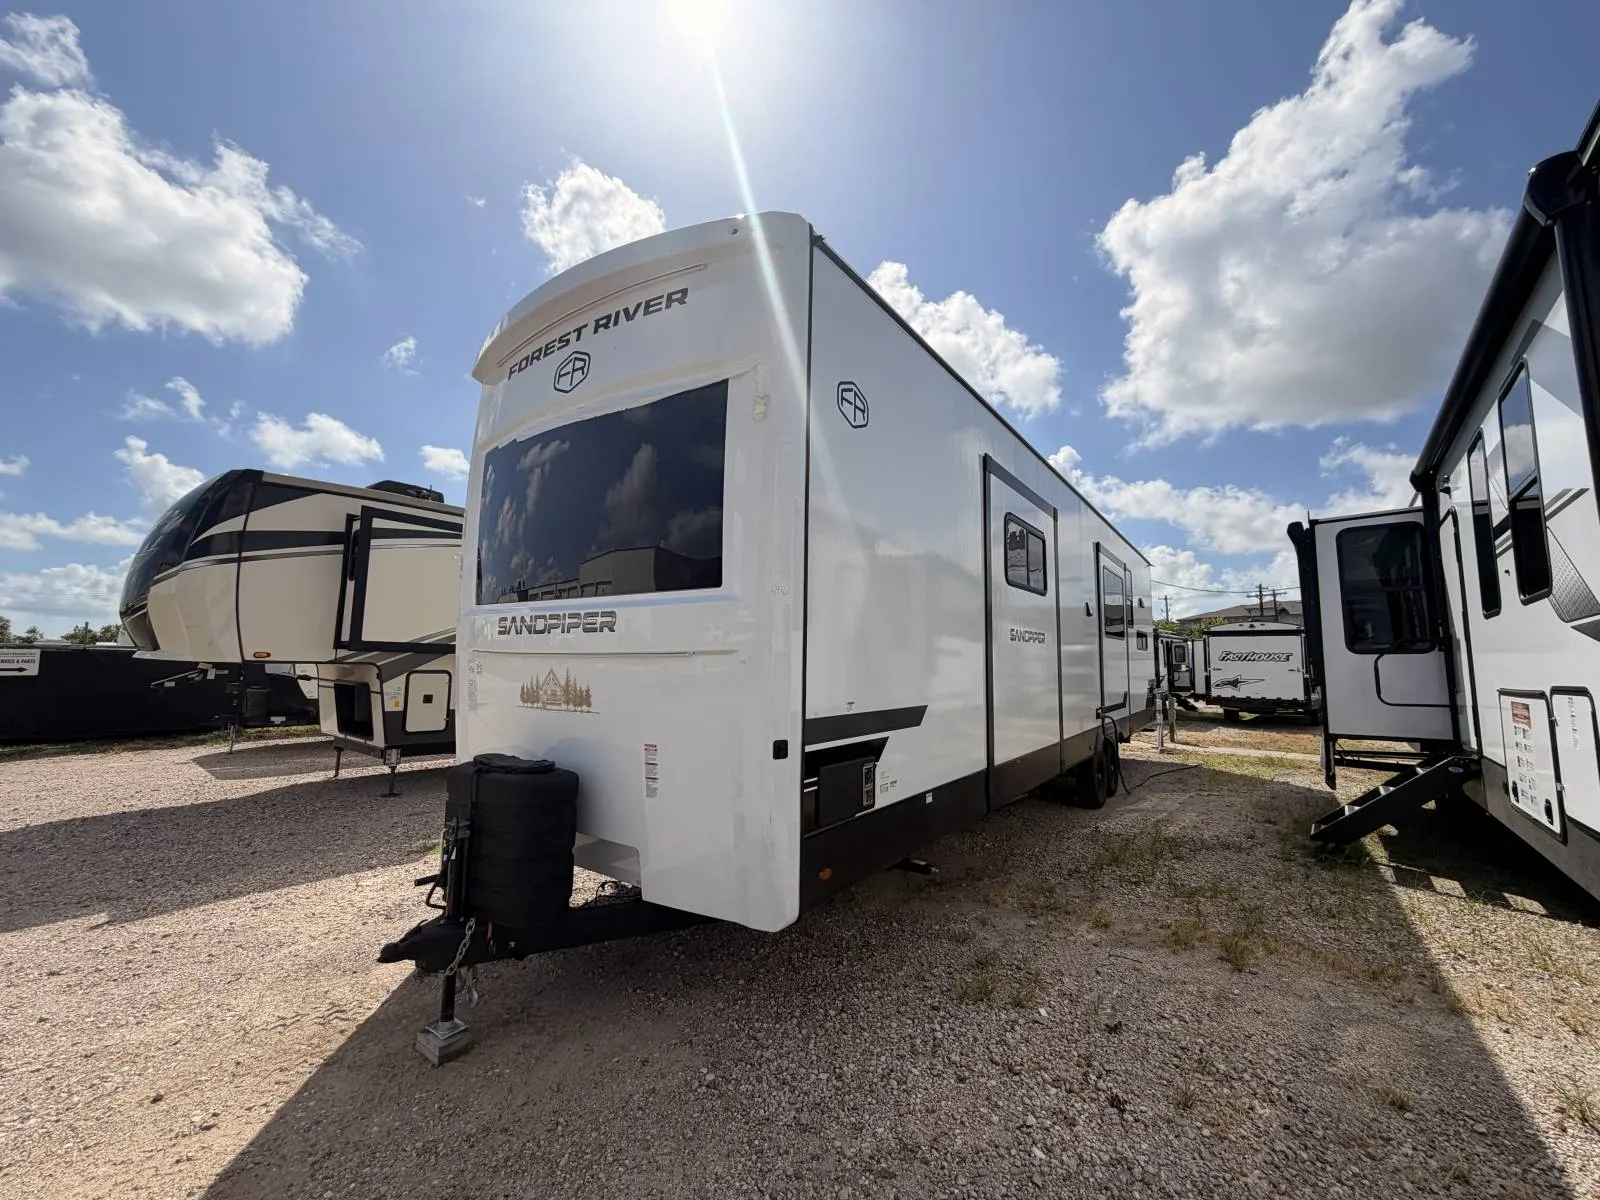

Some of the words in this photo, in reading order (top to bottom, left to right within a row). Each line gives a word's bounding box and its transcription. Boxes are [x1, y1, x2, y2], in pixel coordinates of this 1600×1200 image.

[508, 324, 588, 381] FOREST
[593, 287, 689, 335] RIVER
[497, 610, 617, 636] SANDPIPER
[1009, 627, 1046, 644] SANDPIPER
